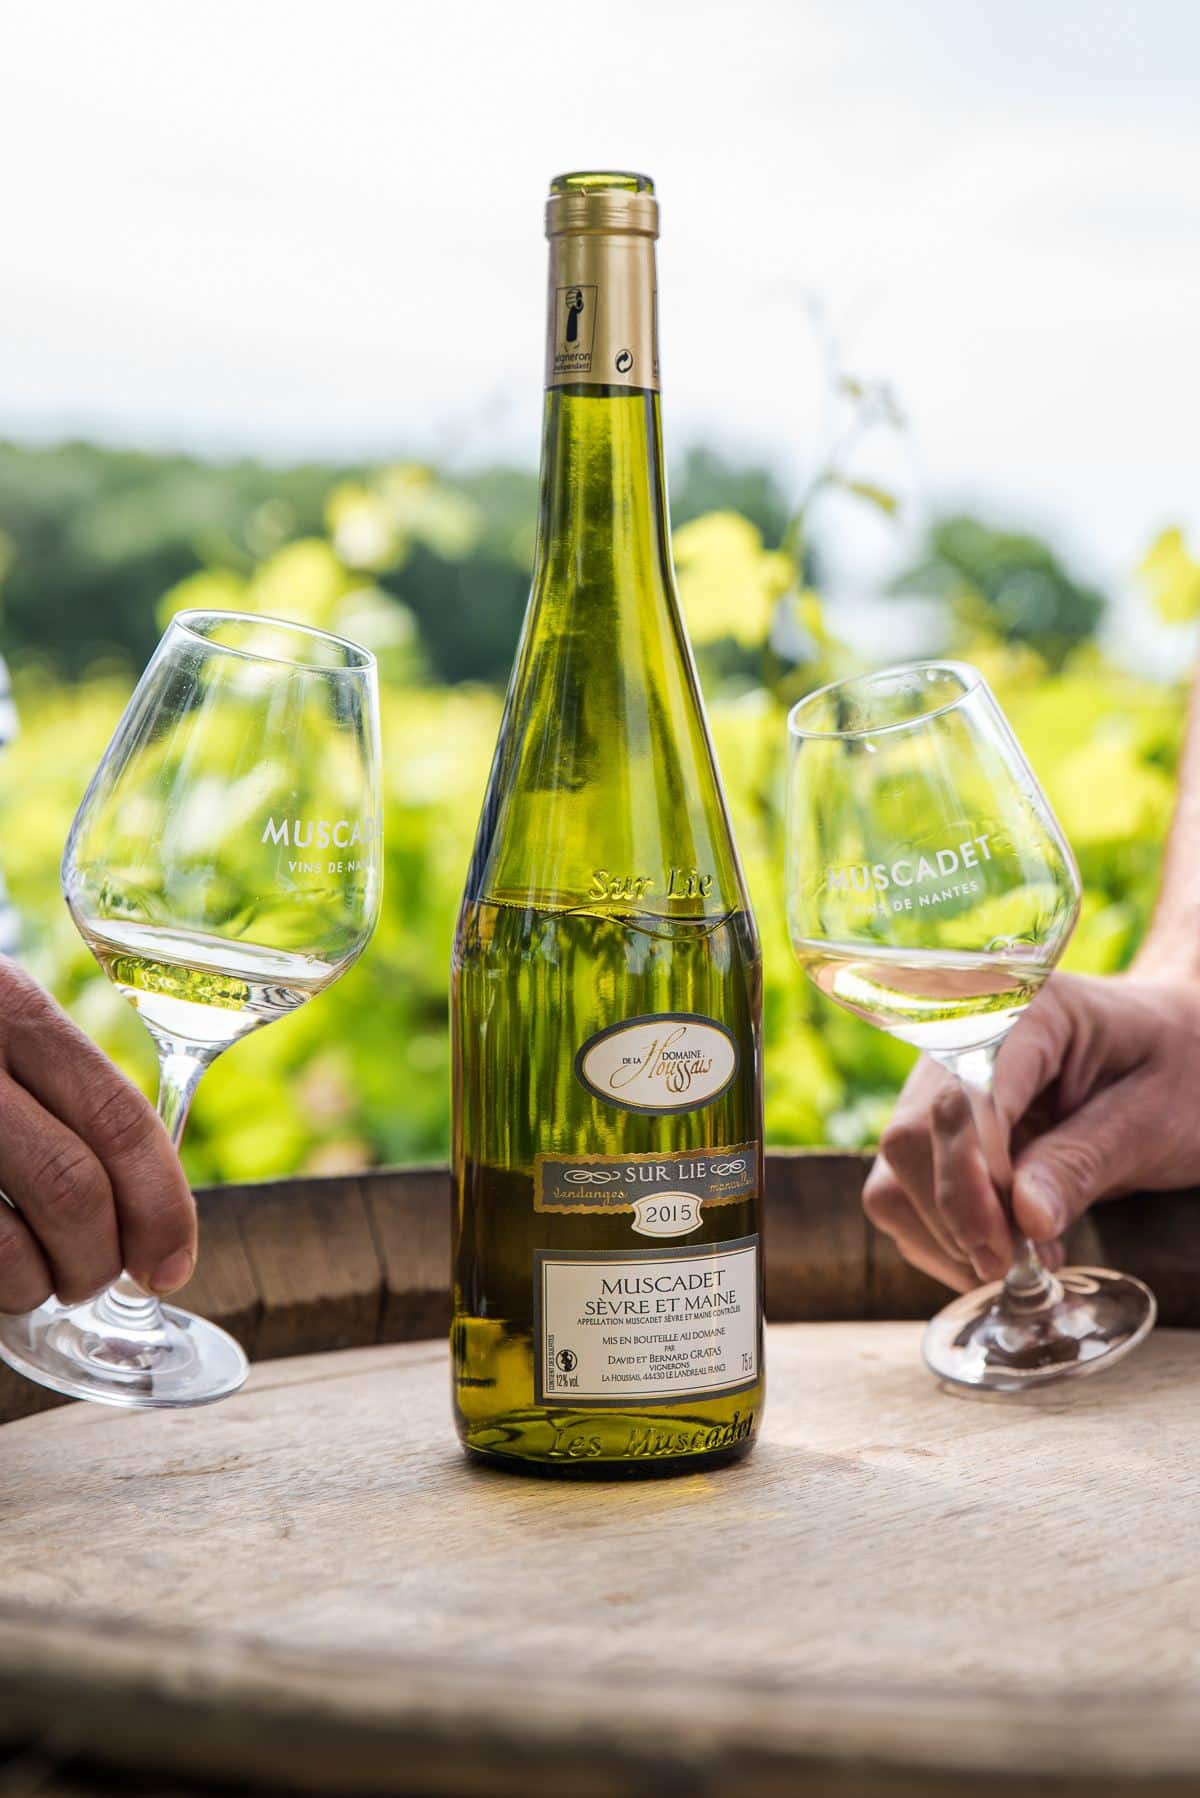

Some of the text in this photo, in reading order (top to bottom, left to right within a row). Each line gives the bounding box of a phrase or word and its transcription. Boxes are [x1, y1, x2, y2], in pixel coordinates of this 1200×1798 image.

[288, 861, 321, 873] VINS
[328, 862, 343, 873] DE
[828, 834, 992, 893] MUSCADET
[589, 868, 712, 900] Sur Lie
[893, 898, 913, 912] DE
[919, 880, 978, 907] NANTES
[662, 1050, 702, 1060] DOMAINE
[625, 1162, 706, 1182] SUR LIE
[646, 1204, 692, 1223] 2015
[601, 1270, 726, 1295] MUSCADET
[584, 1290, 736, 1316] SÈVRE ET MAINE
[626, 1316, 663, 1324] MUSCADET
[664, 1313, 684, 1322] SÈVRE
[694, 1311, 712, 1319] MAINE
[602, 1327, 726, 1344] MIS EN BOUTEILLE AU DOMAINE
[608, 1356, 635, 1364] DAVID
[650, 1353, 688, 1363] BERNARD
[690, 1346, 722, 1360] GRATAS
[602, 1374, 609, 1382] LA
[642, 1372, 665, 1380] 44430
[708, 1364, 726, 1373] FRANCE
[650, 1362, 690, 1371] VIGNERONS
